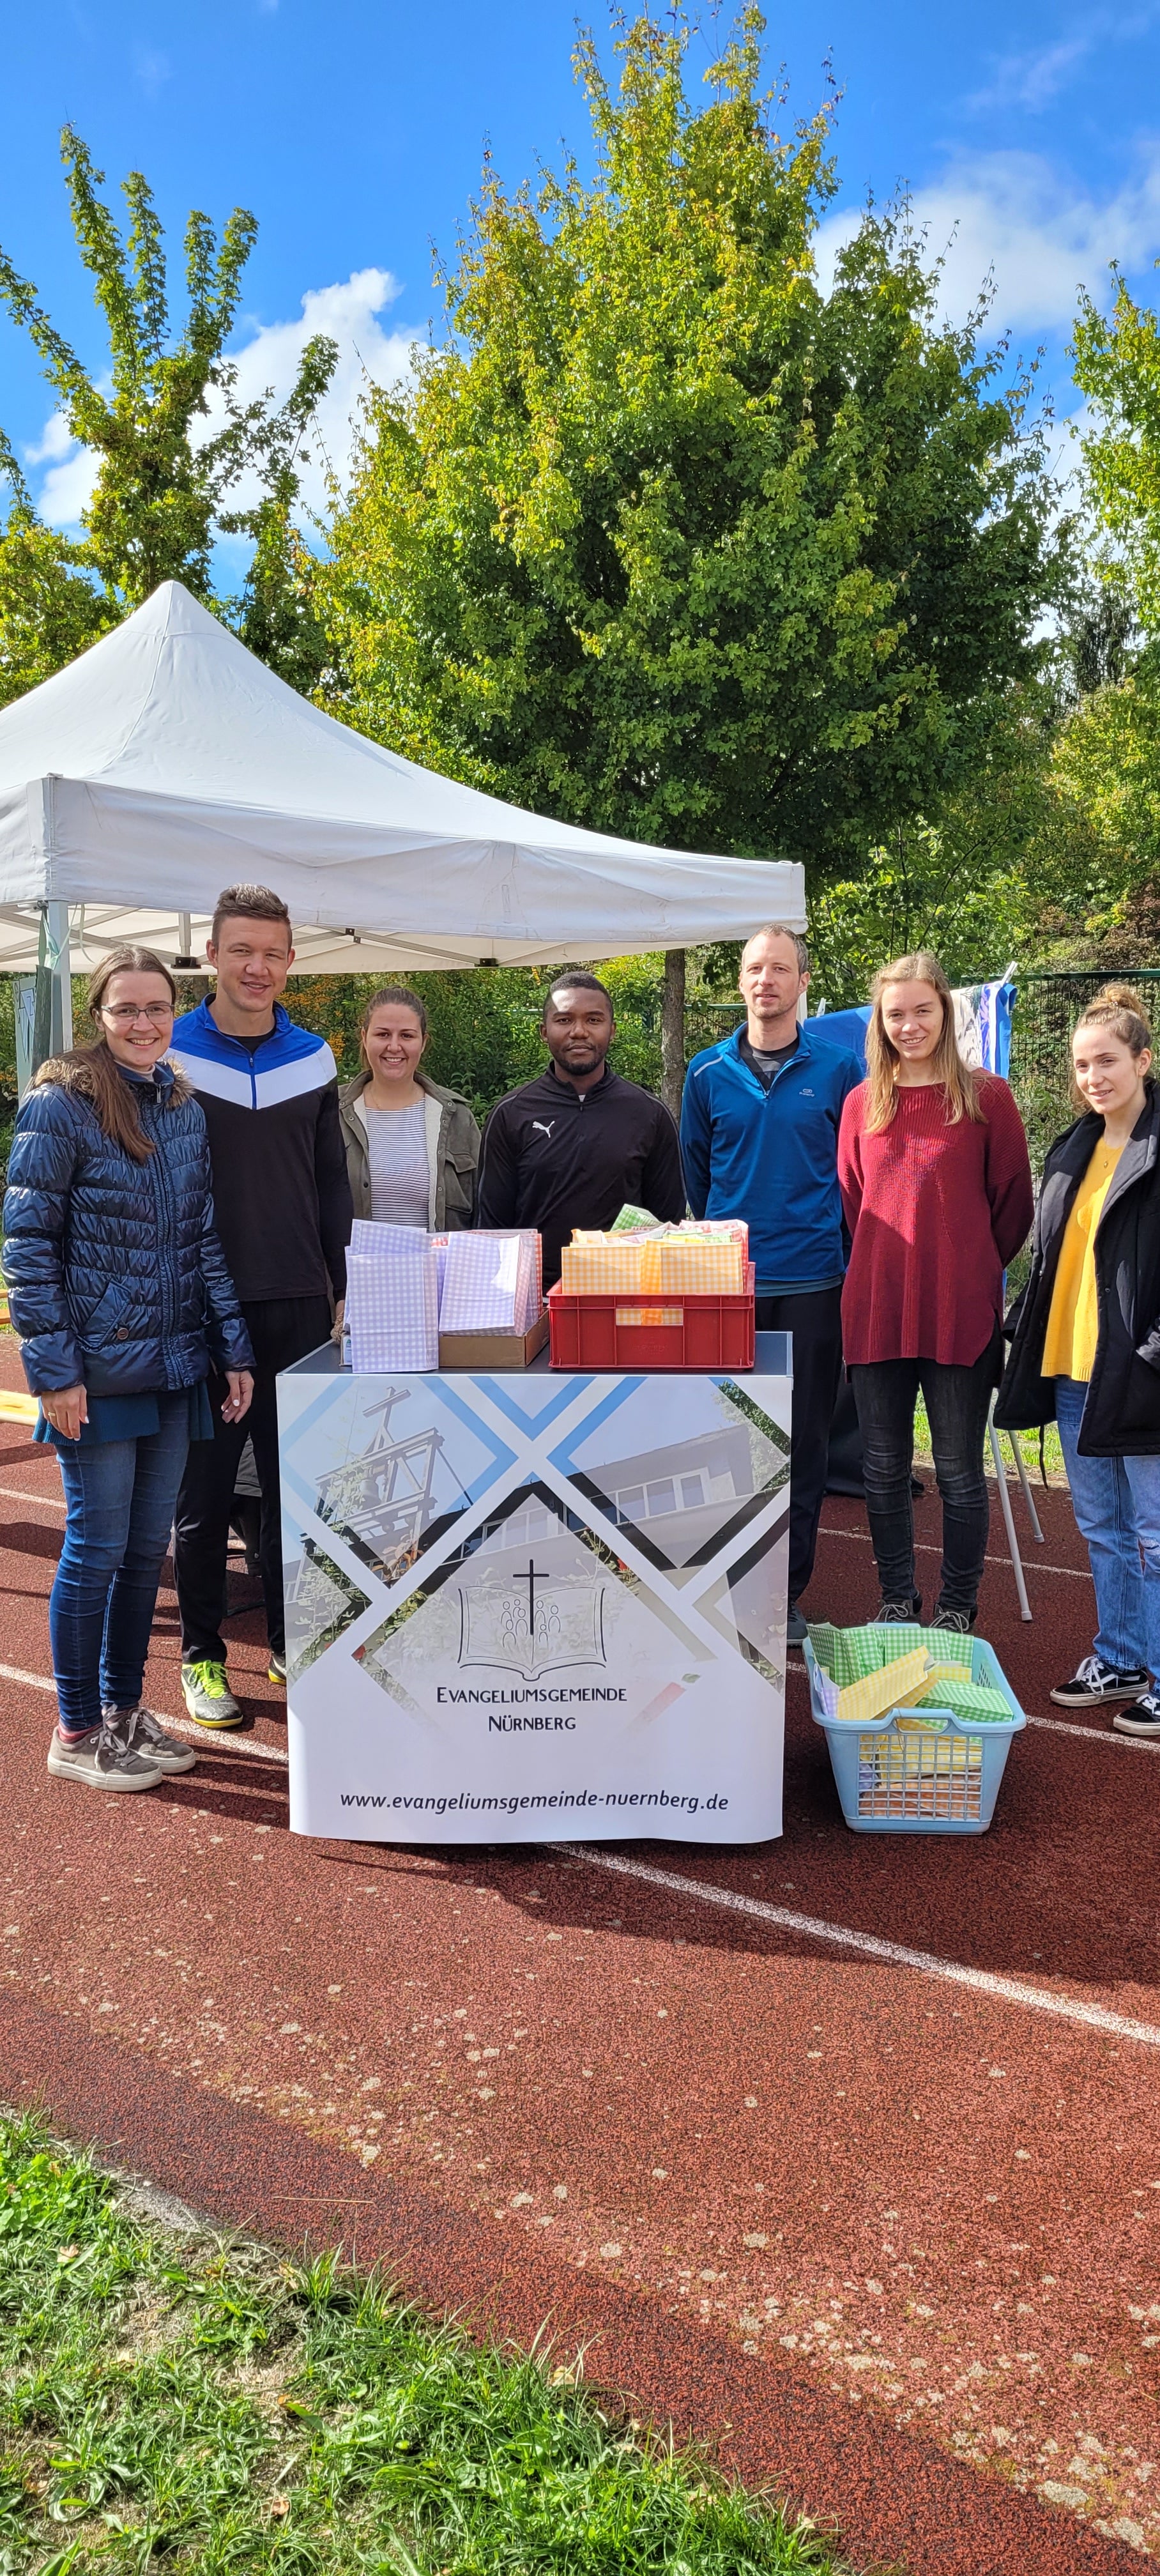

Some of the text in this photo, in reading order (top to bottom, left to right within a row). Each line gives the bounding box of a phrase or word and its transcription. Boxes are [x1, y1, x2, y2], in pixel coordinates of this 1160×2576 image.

[436, 1687, 627, 1703] EVANGELIUMSGEMEINDE
[488, 1715, 576, 1732] NÜRNBERG
[340, 1790, 729, 1815] www.evangeliumsgemeinde-nuernberg.de
